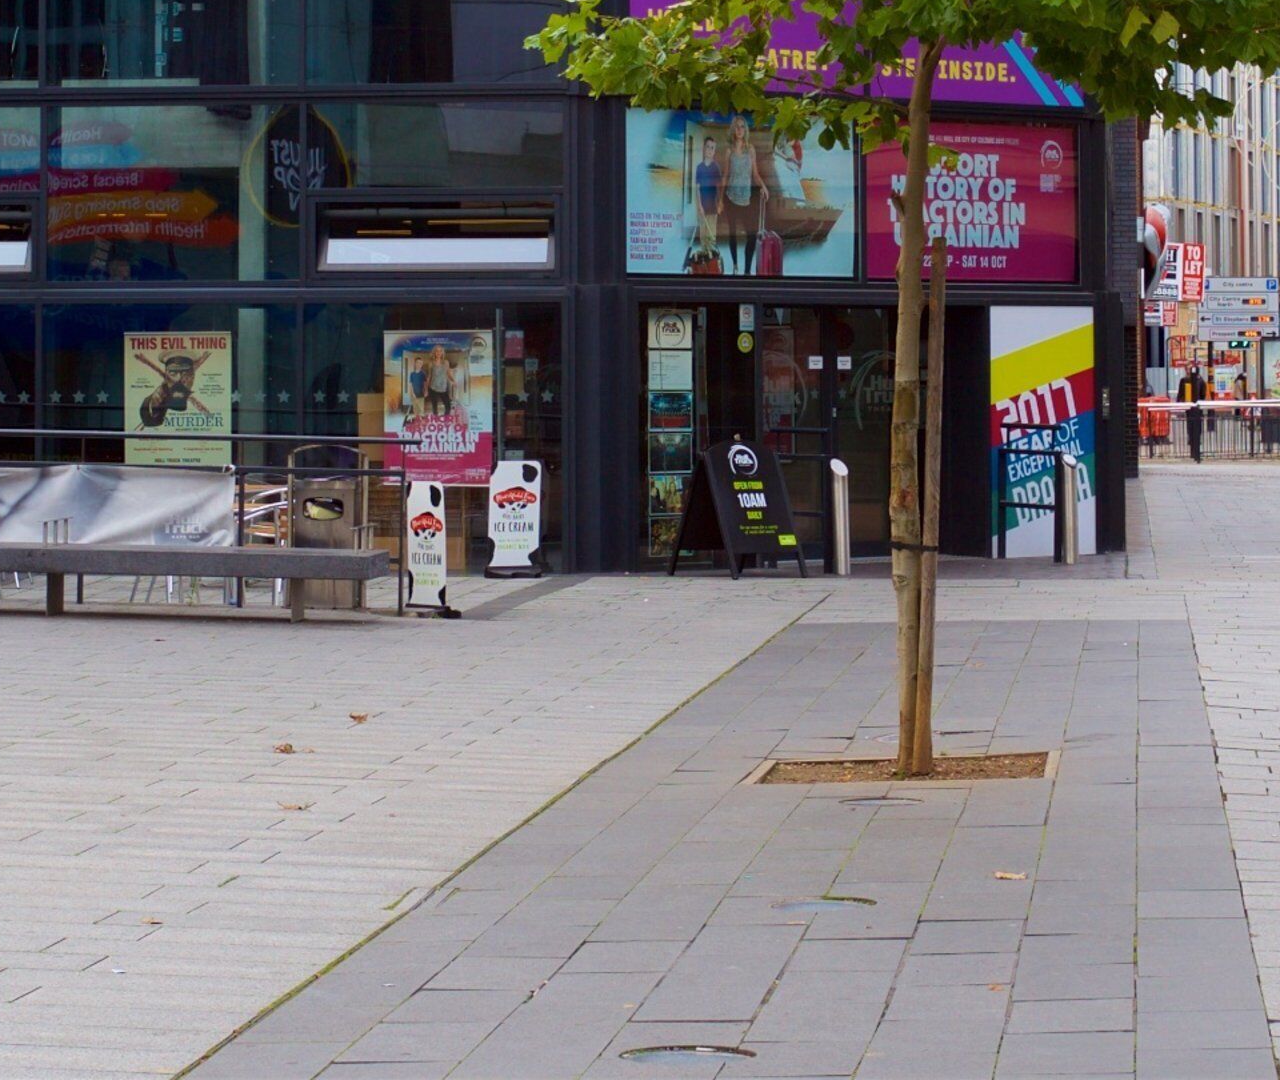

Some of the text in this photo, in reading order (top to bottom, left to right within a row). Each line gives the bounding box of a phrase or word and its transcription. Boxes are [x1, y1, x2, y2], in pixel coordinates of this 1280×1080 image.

[938, 60, 1017, 83] INSIDE.
[891, 174, 1016, 201] HTORY OF
[1003, 202, 1026, 226] IN
[1186, 245, 1201, 260] TO
[962, 256, 977, 268] SAT
[980, 256, 989, 267] 14
[991, 256, 1007, 268] OCT
[1185, 261, 1202, 275] LET
[129, 336, 227, 350] THIS EVIL THING
[996, 378, 1077, 444] 2017
[164, 416, 223, 427] MURDER
[1057, 418, 1079, 442] OF
[737, 492, 767, 508] 10AM
[1012, 462, 1094, 523] DRAA
[494, 521, 534, 532] ICE CREAM
[422, 552, 442, 565] CREAM
